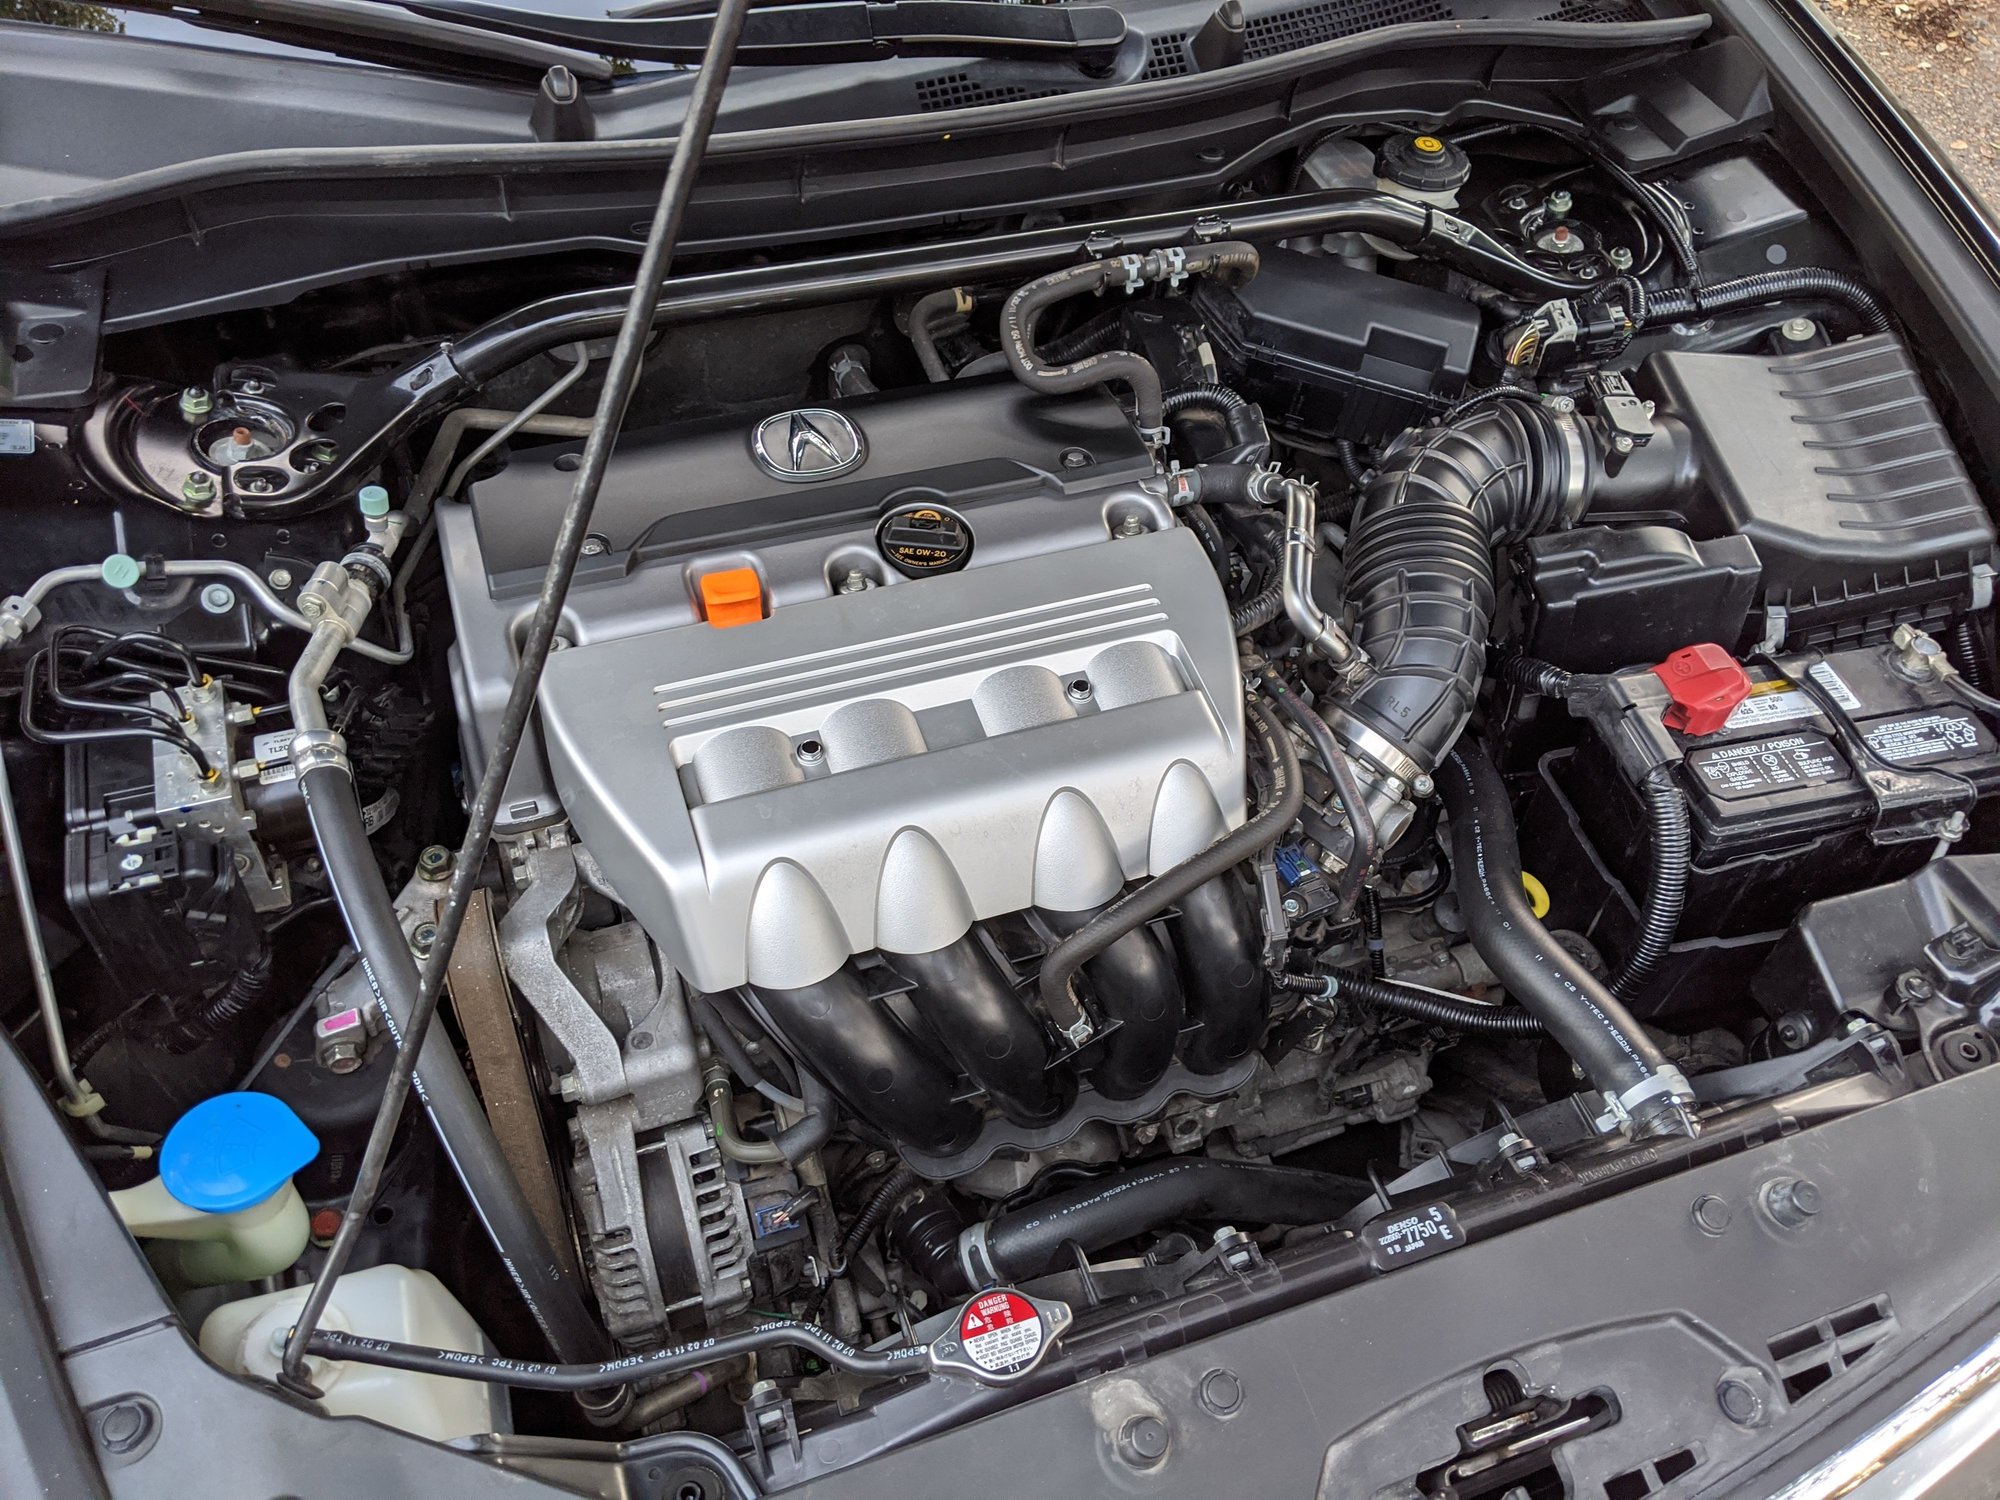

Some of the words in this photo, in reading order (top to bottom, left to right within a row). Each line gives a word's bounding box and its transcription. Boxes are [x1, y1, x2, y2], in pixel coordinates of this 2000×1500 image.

[899, 546, 915, 555] SAE
[904, 558, 928, 566] OWNER'S
[1385, 696, 1412, 718] RL5
[1721, 745, 1759, 758] DANGER
[1768, 738, 1805, 750] POISON
[1580, 995, 1605, 1020] Y-TEC
[1428, 1207, 1443, 1222] 5
[1387, 1217, 1419, 1234] DENSO
[1439, 1225, 1453, 1240] E
[1405, 1240, 1425, 1253] JAPAN
[978, 1294, 1008, 1309] DANGER
[981, 1302, 1010, 1317] WARNUNG
[805, 1322, 824, 1338] TPC
[687, 1343, 701, 1351] 02
[492, 1358, 513, 1369] TPC
[1008, 1363, 1020, 1373] 1.1
